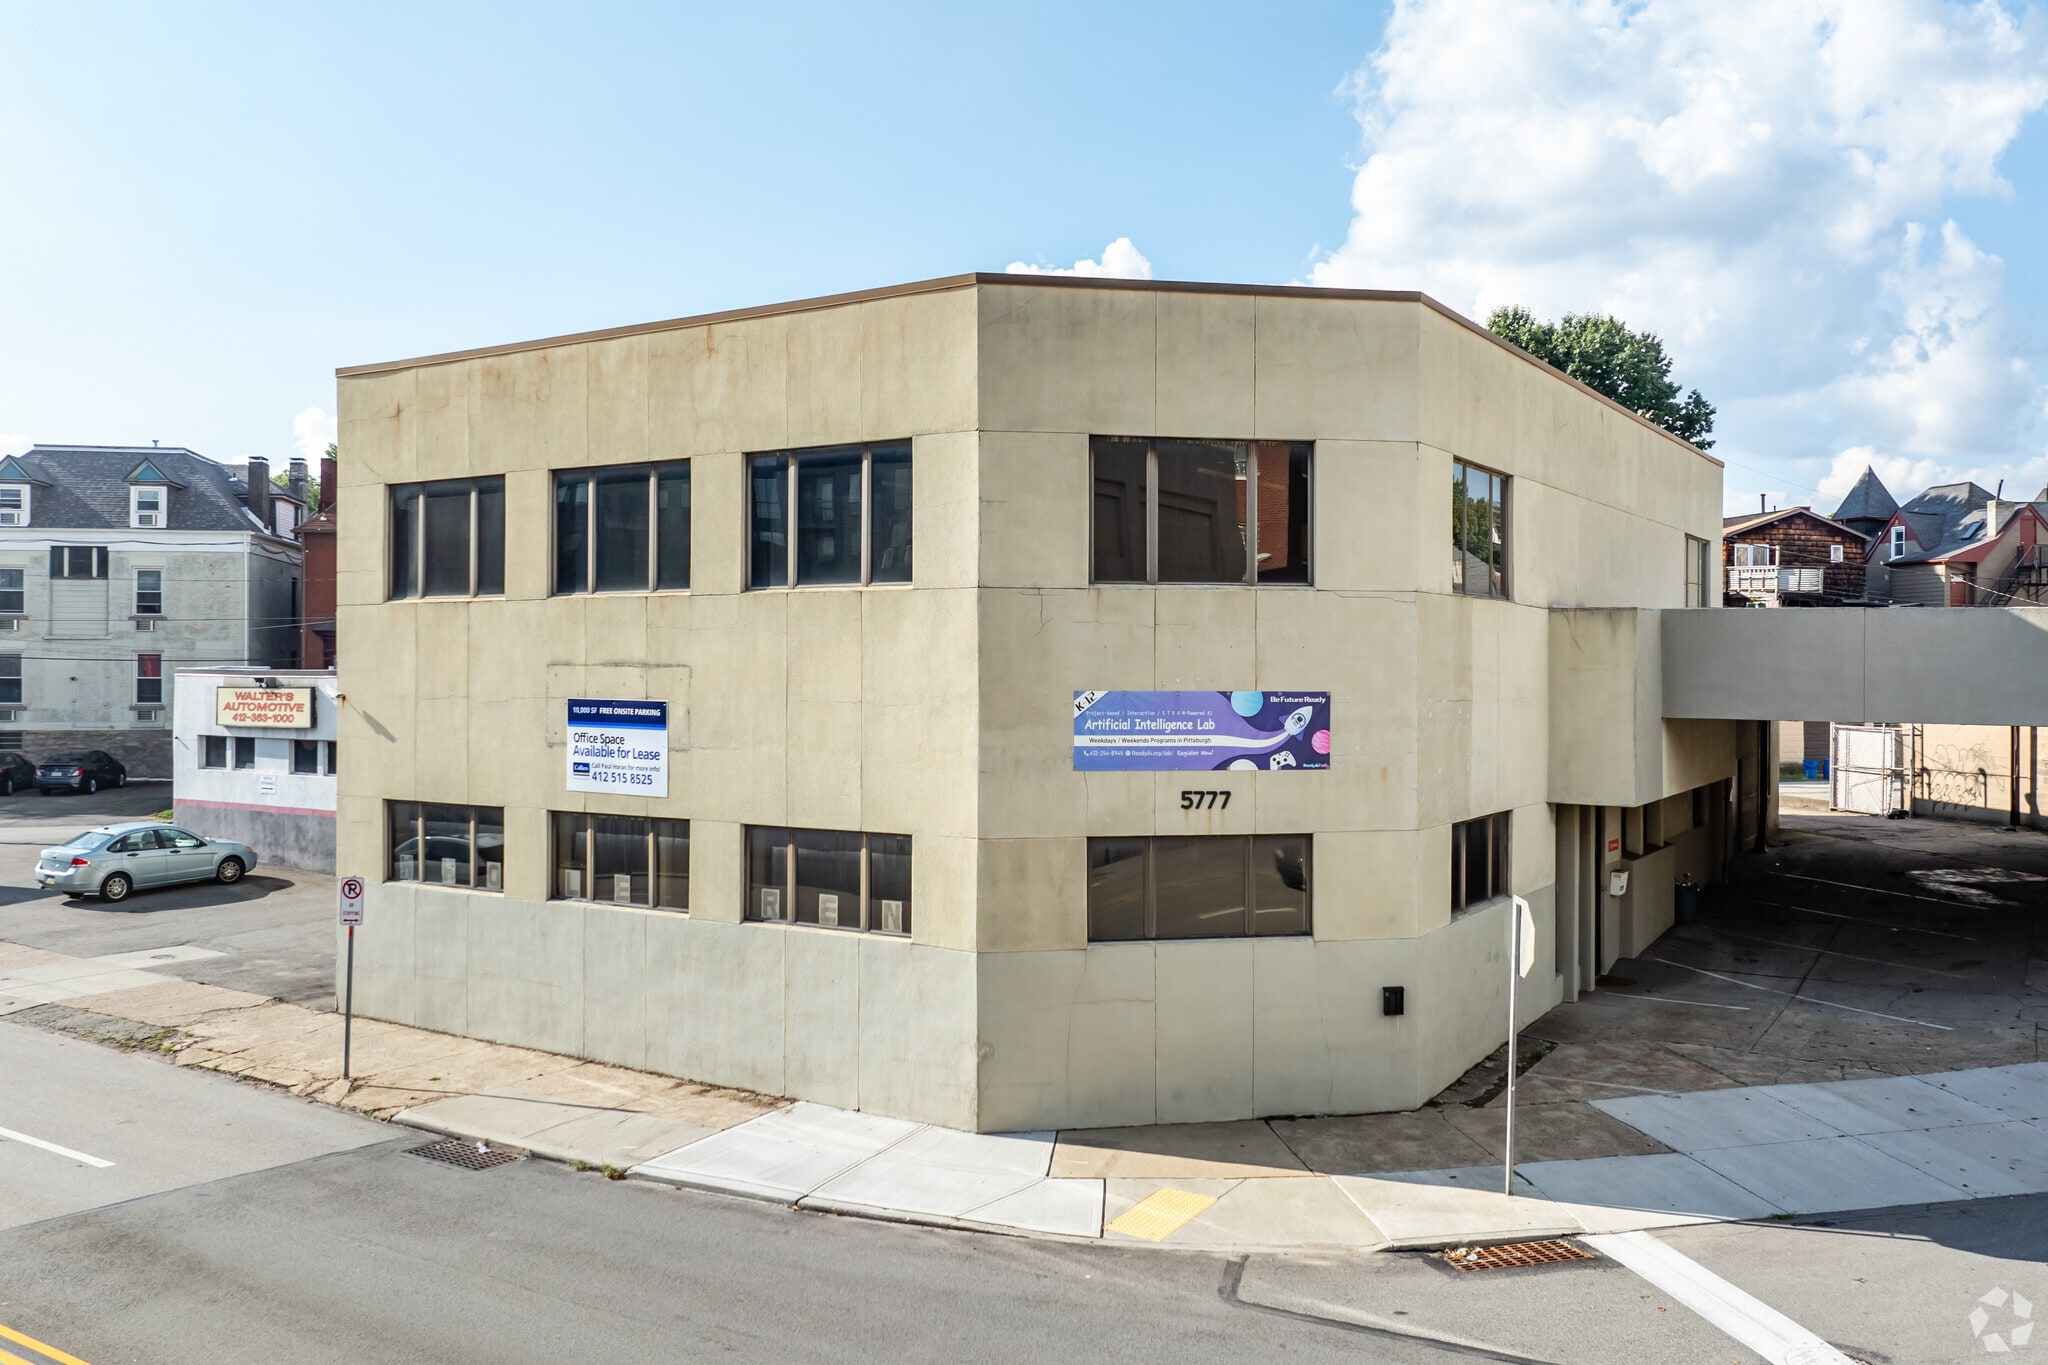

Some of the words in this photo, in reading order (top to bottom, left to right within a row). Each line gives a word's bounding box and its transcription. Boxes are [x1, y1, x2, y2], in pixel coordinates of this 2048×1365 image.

[235, 691, 294, 702] WALTER'S
[1075, 691, 1097, 711] K-12
[1304, 696, 1326, 704] Ready
[223, 702, 304, 713] AUTOMOTIVE
[599, 707, 613, 715] FREE
[613, 707, 634, 715] ONSITE
[634, 708, 661, 716] PARKING
[1085, 718, 1131, 730] Artificial
[1134, 718, 1193, 733] Intelligence
[1197, 718, 1216, 730] Lab
[573, 732, 598, 744] Office
[600, 733, 625, 747] Space
[573, 745, 615, 758] Available
[617, 746, 630, 759] for
[632, 748, 660, 761] Lease
[592, 771, 609, 782] 412
[611, 772, 627, 783] 515
[630, 773, 653, 785] 8525
[1181, 791, 1232, 810] 5777
